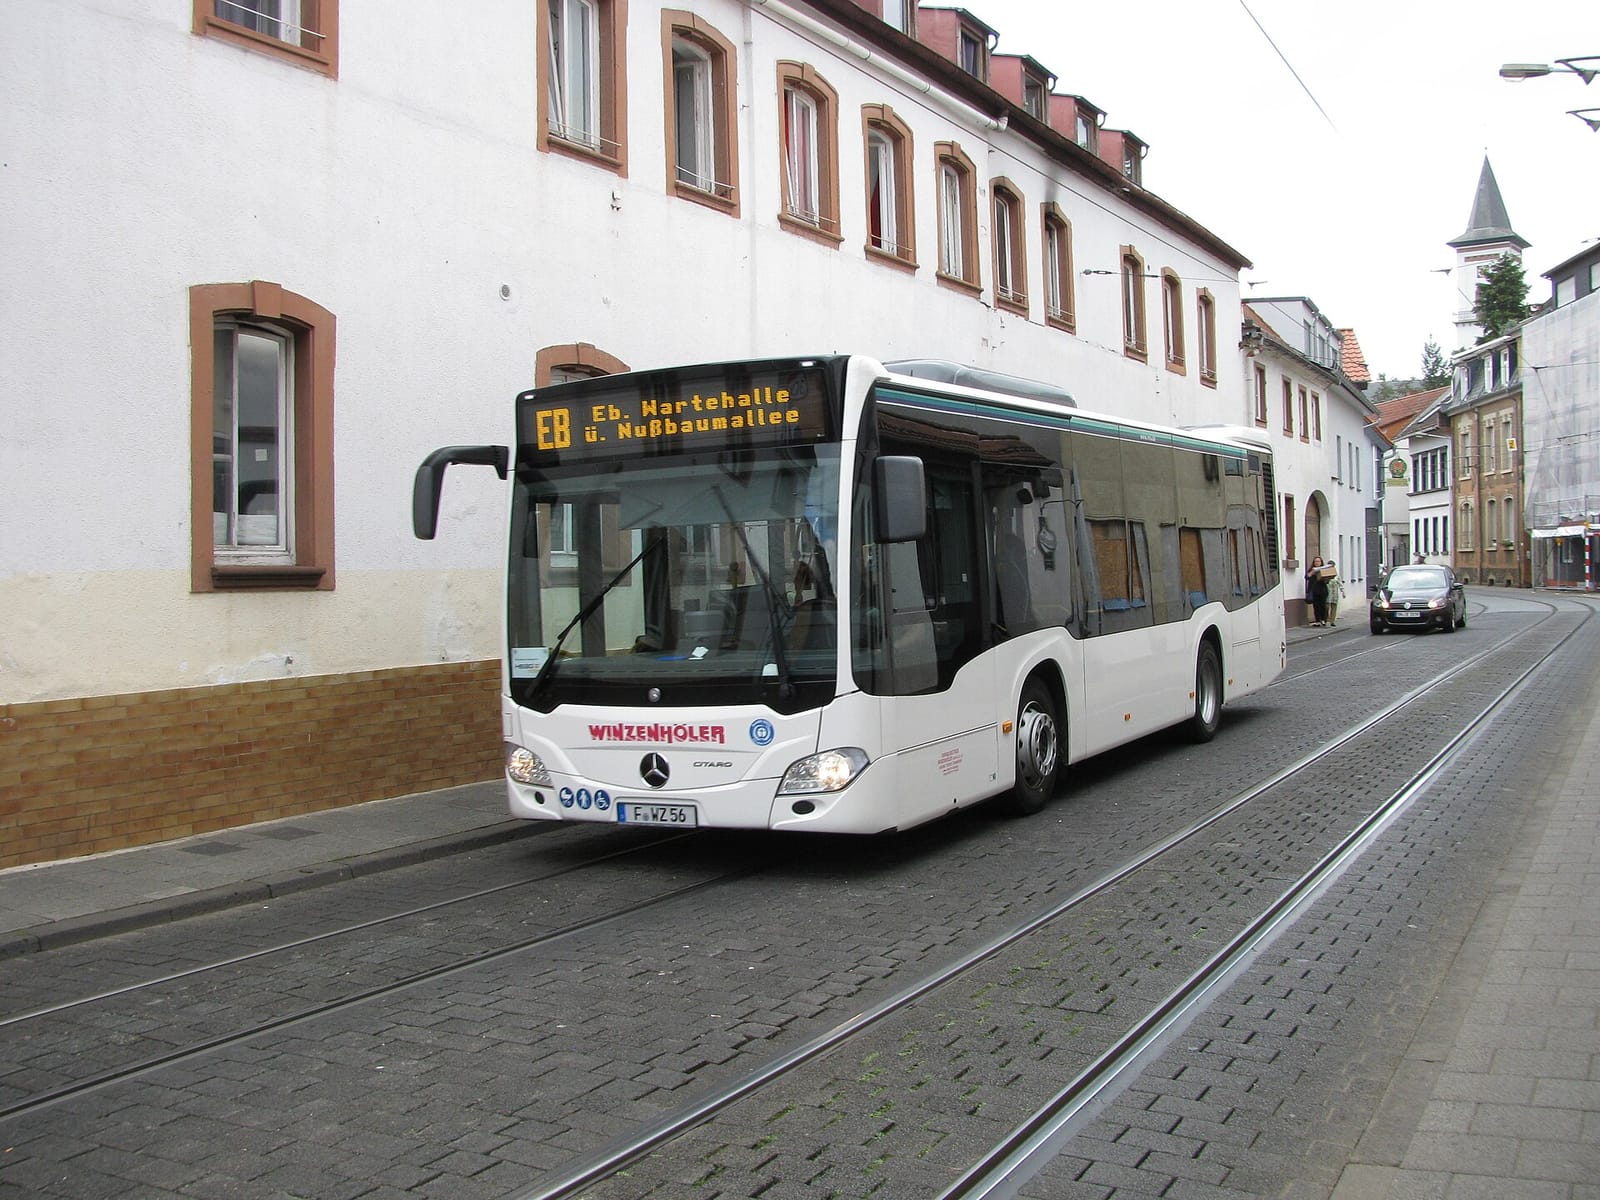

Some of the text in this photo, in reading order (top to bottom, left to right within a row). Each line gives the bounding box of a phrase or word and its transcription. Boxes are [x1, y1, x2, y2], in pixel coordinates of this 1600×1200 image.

[592, 386, 791, 423] Eb. Wartehalle
[535, 408, 572, 451] EB
[584, 409, 800, 443] ü. Nußbaumallee
[588, 723, 725, 744] WINZENHÖLER
